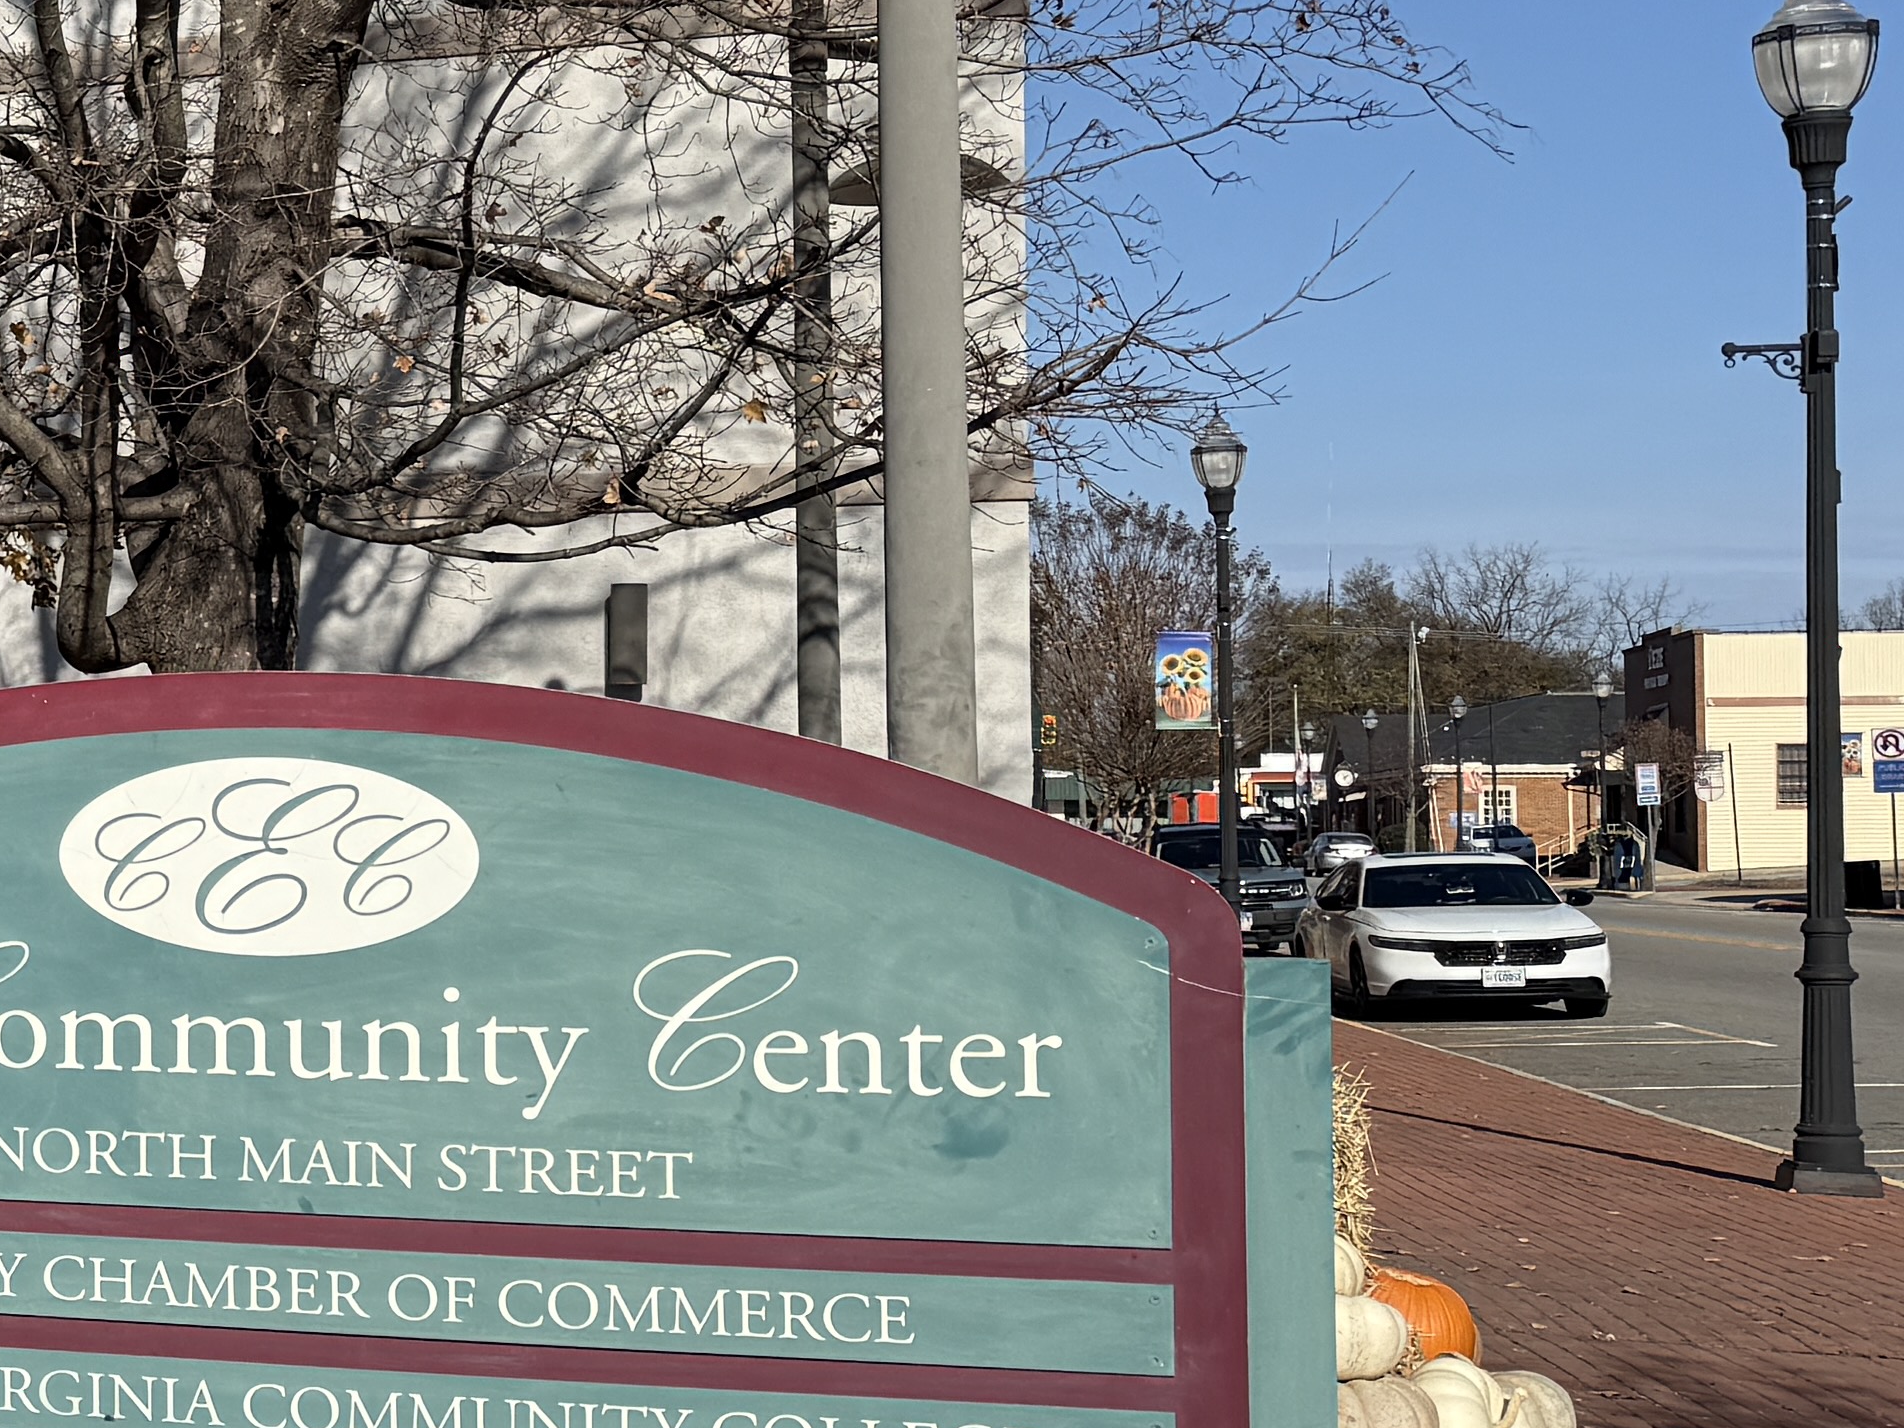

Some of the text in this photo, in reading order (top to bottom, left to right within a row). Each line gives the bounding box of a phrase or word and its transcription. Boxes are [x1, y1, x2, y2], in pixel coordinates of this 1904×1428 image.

[632, 948, 1063, 1098] Center
[237, 1136, 417, 1189] MAIN
[437, 1143, 694, 1200] STREET
[43, 1254, 371, 1319] CHAMBER
[387, 1273, 476, 1323] OF
[498, 1279, 915, 1344] COMMERCE
